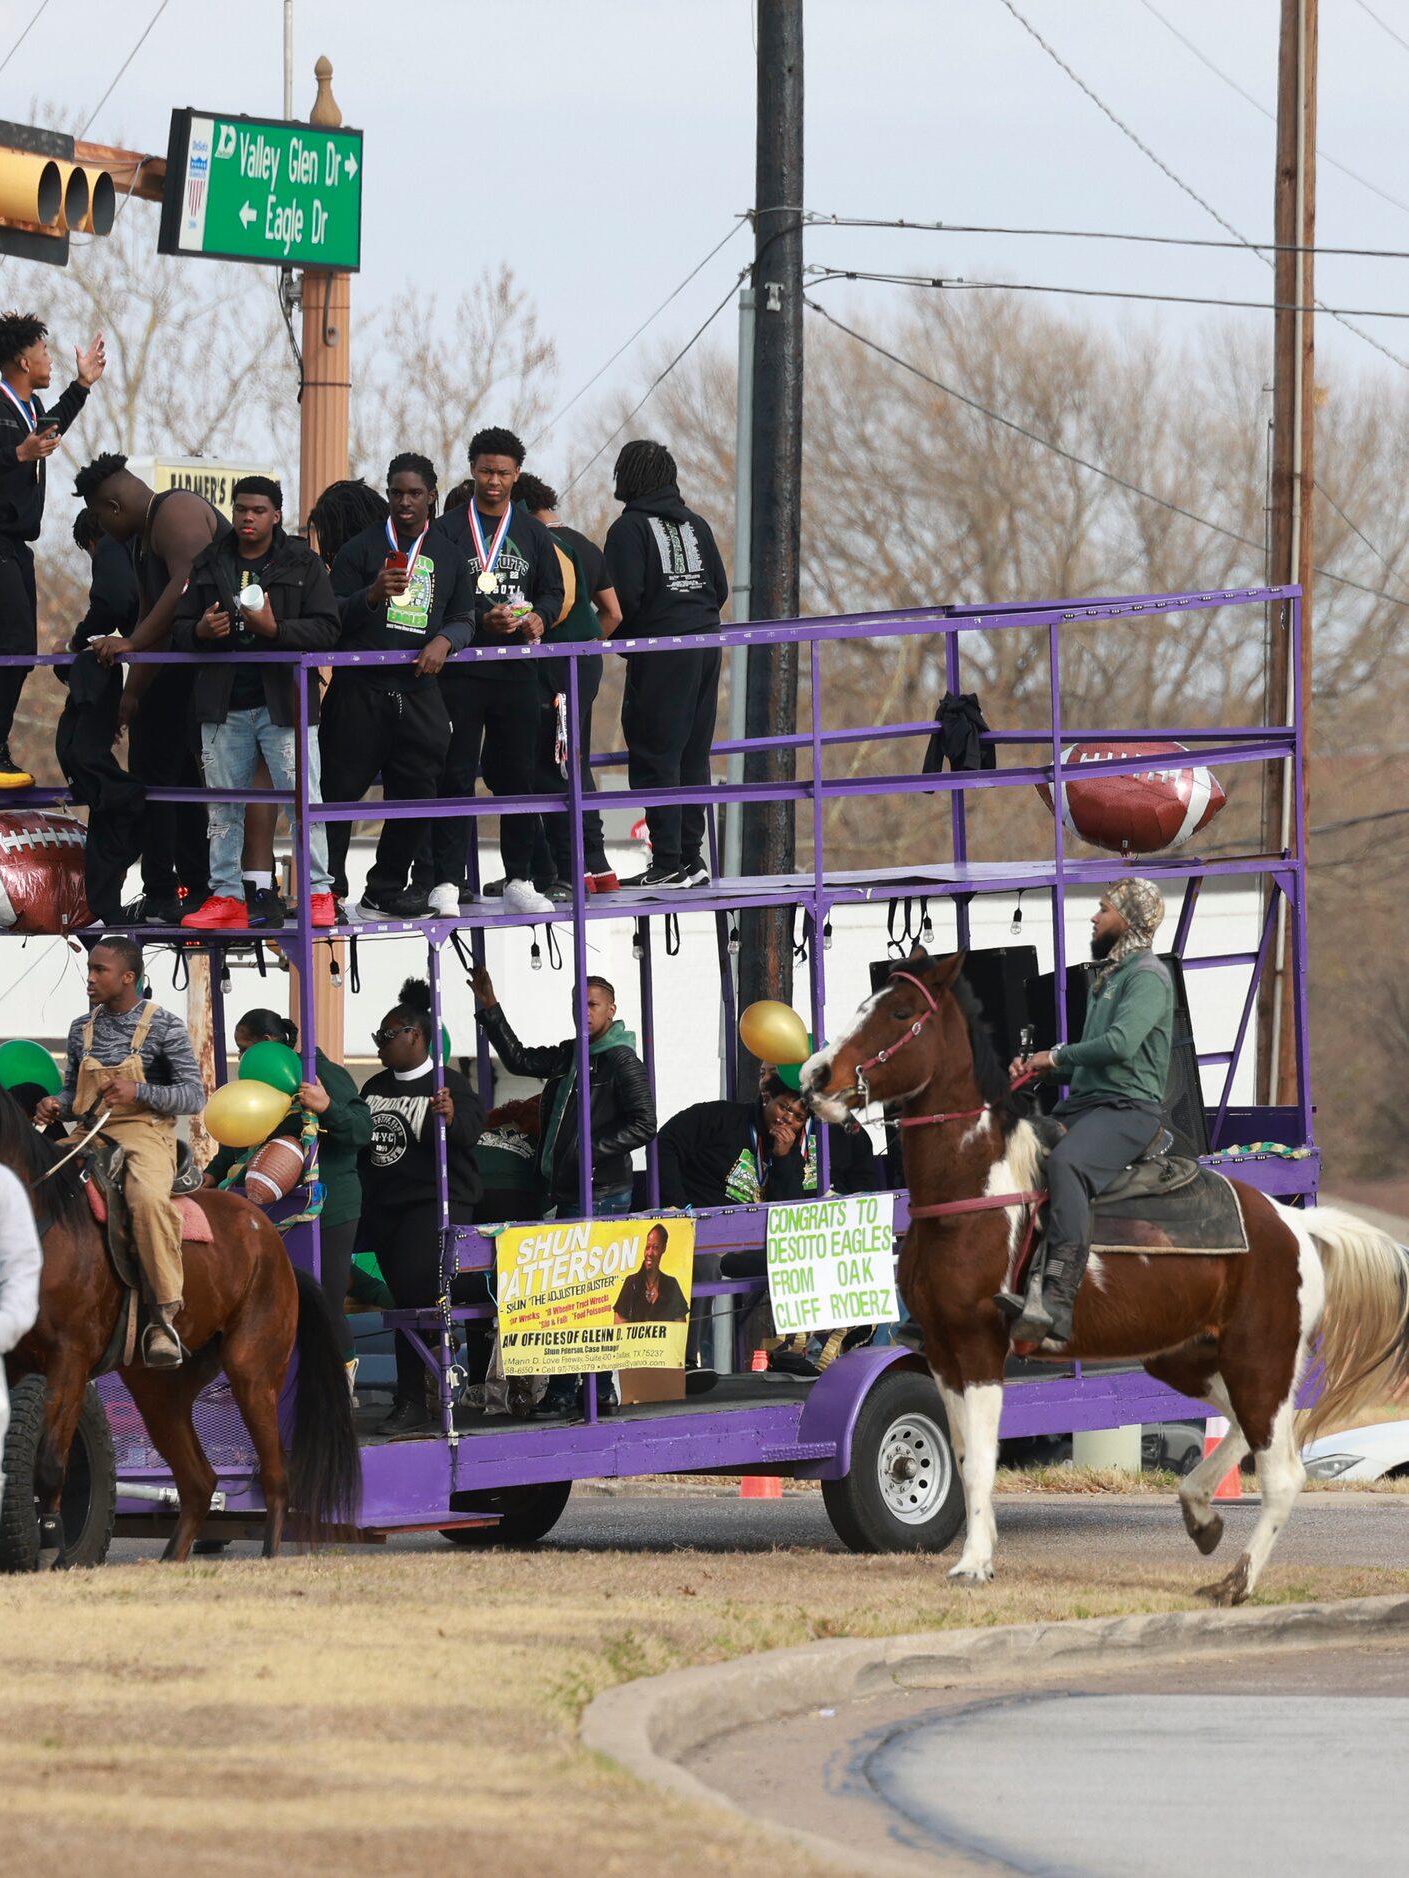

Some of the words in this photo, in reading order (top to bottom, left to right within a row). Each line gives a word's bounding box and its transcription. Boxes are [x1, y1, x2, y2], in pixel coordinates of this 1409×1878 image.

[240, 132, 281, 193] Valley
[288, 137, 318, 185] Glen
[325, 141, 342, 187] Dr
[265, 194, 304, 256] Eagle
[311, 199, 329, 245] Dr
[468, 554, 530, 577] PLOFFS
[475, 585, 521, 594] SOT
[769, 1200, 847, 1235] CONGRATS
[856, 1198, 878, 1225] TO
[516, 1223, 591, 1265] SHUN
[768, 1233, 827, 1264] DESOTO
[831, 1224, 891, 1257] EAGLES
[771, 1266, 814, 1297] FROM
[837, 1257, 874, 1287] OAK
[506, 1300, 526, 1314] SHUN
[775, 1297, 820, 1329] CLIFF
[830, 1289, 893, 1320] RYDERZ
[582, 1328, 614, 1343] GLENN
[626, 1325, 667, 1340] TUCKER
